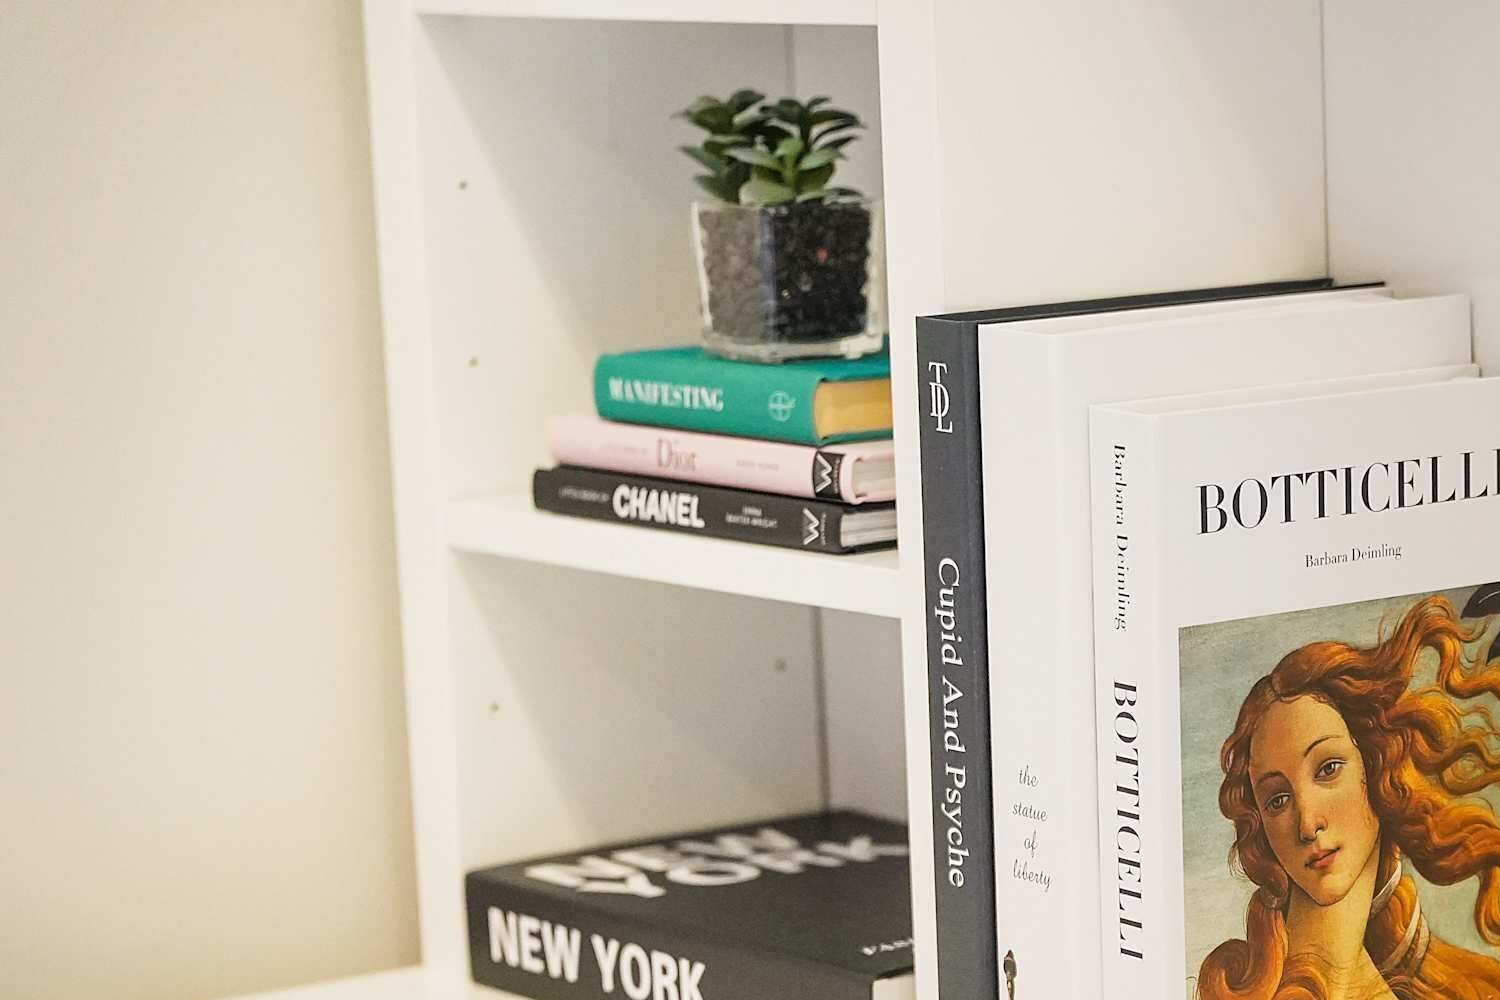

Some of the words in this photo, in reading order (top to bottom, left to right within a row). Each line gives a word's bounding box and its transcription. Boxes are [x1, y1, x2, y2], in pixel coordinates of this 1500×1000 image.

[608, 376, 724, 412] MANIFESTING
[657, 437, 697, 472] Dior
[612, 484, 705, 528] CHANEL
[1114, 445, 1126, 525] Barbara
[1304, 550, 1348, 568] Barbara
[1351, 543, 1402, 561] Deimling
[1114, 535, 1130, 631] Deimling
[935, 557, 964, 666] Cupid
[942, 676, 967, 753] And
[1019, 763, 1039, 787] the
[941, 762, 970, 888] Psyche
[1012, 801, 1048, 822] statue
[1112, 679, 1145, 961] BOTTICELLI
[1024, 829, 1039, 858] of
[1013, 858, 1052, 893] liberty
[487, 906, 580, 984] NEW
